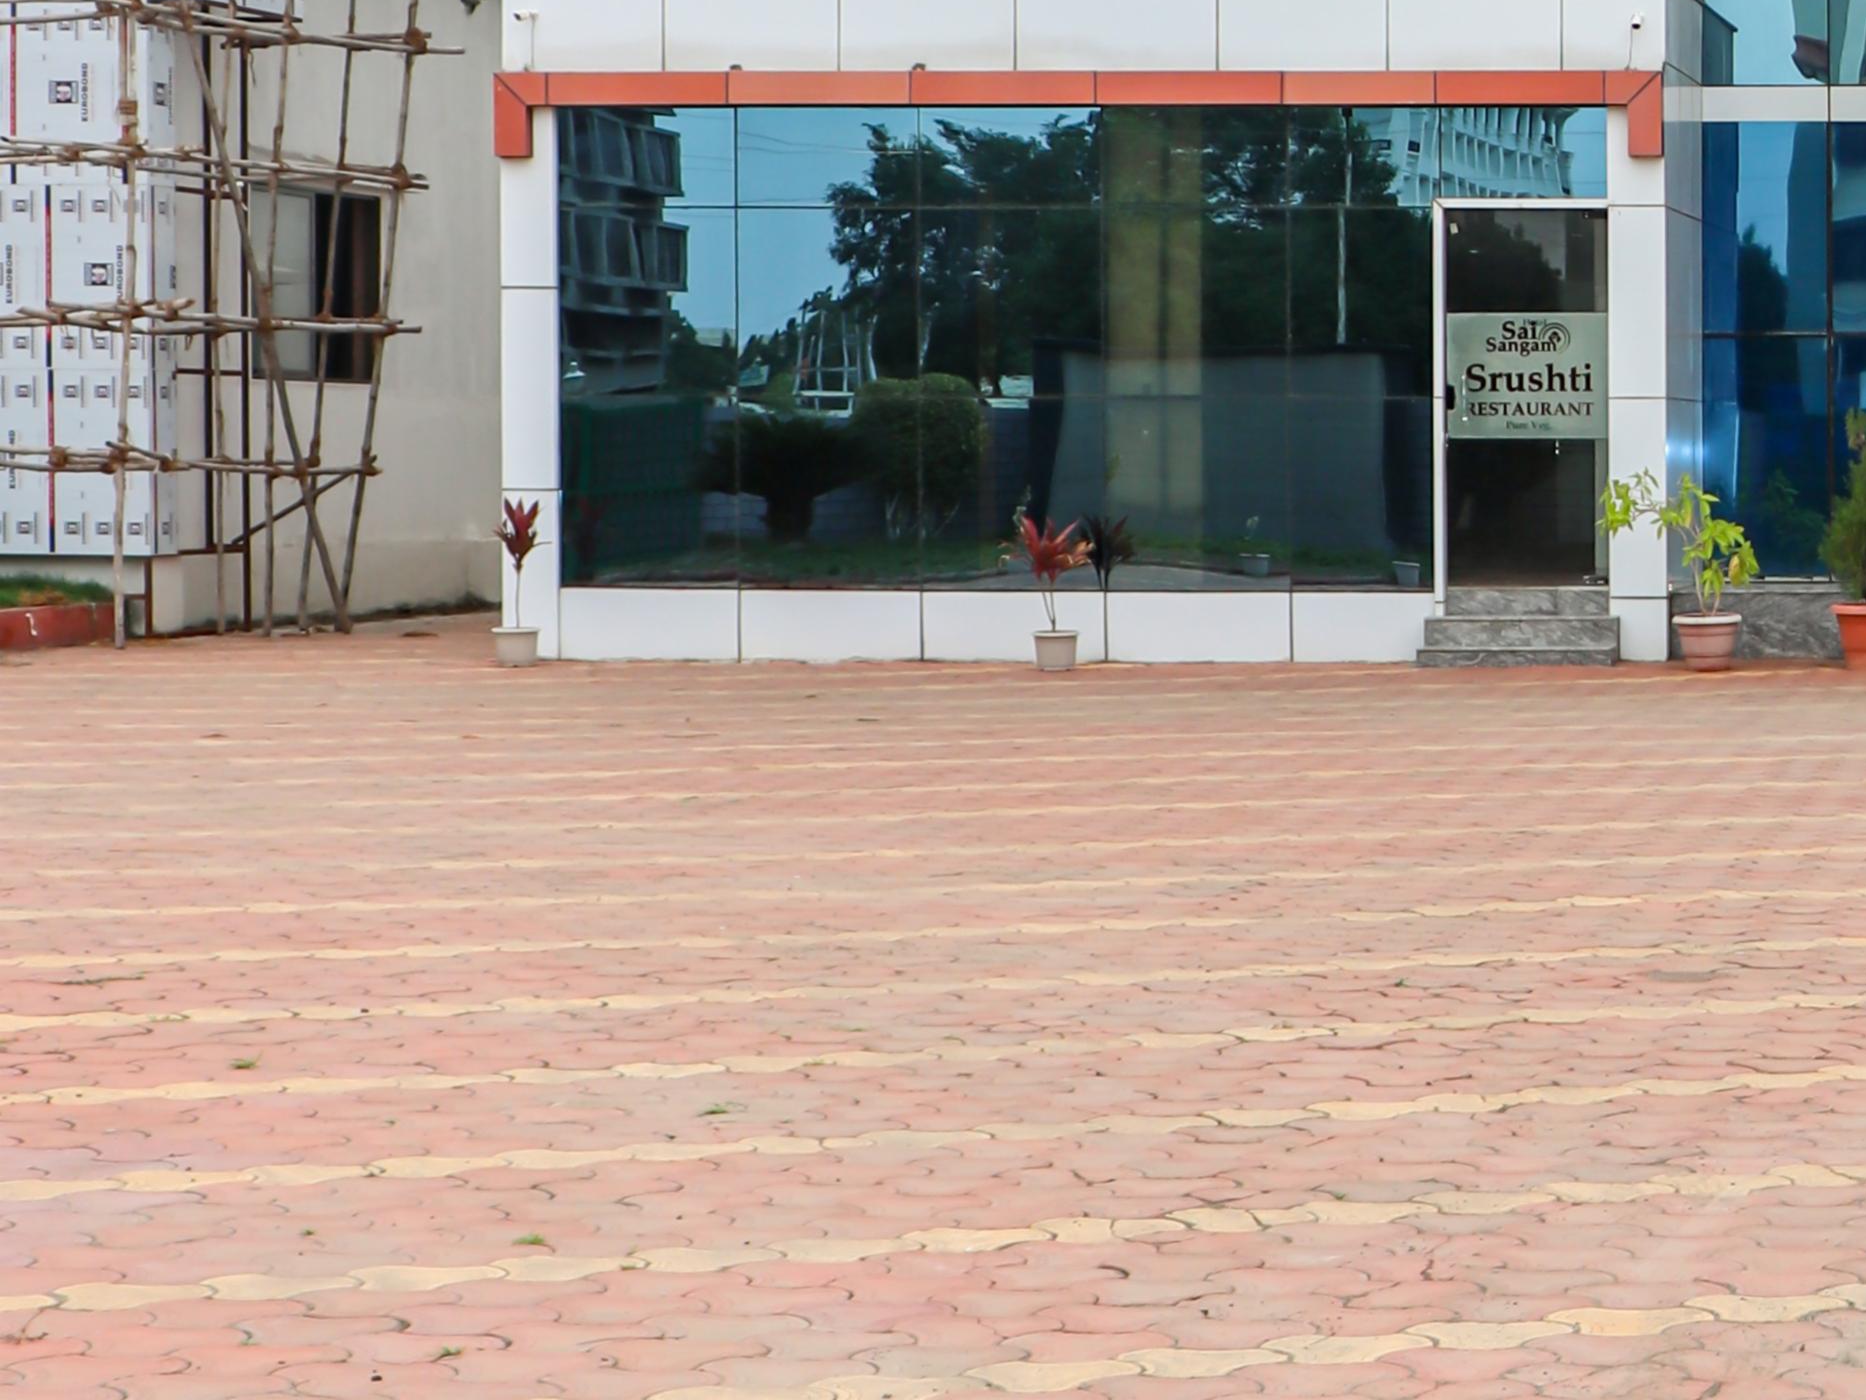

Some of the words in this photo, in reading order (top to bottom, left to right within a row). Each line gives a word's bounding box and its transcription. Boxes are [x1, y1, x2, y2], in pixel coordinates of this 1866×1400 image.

[1501, 320, 1537, 341] Sai
[1486, 337, 1557, 357] Sangam
[1466, 363, 1593, 393] Srushti
[1468, 401, 1594, 417] RESTAURANT
